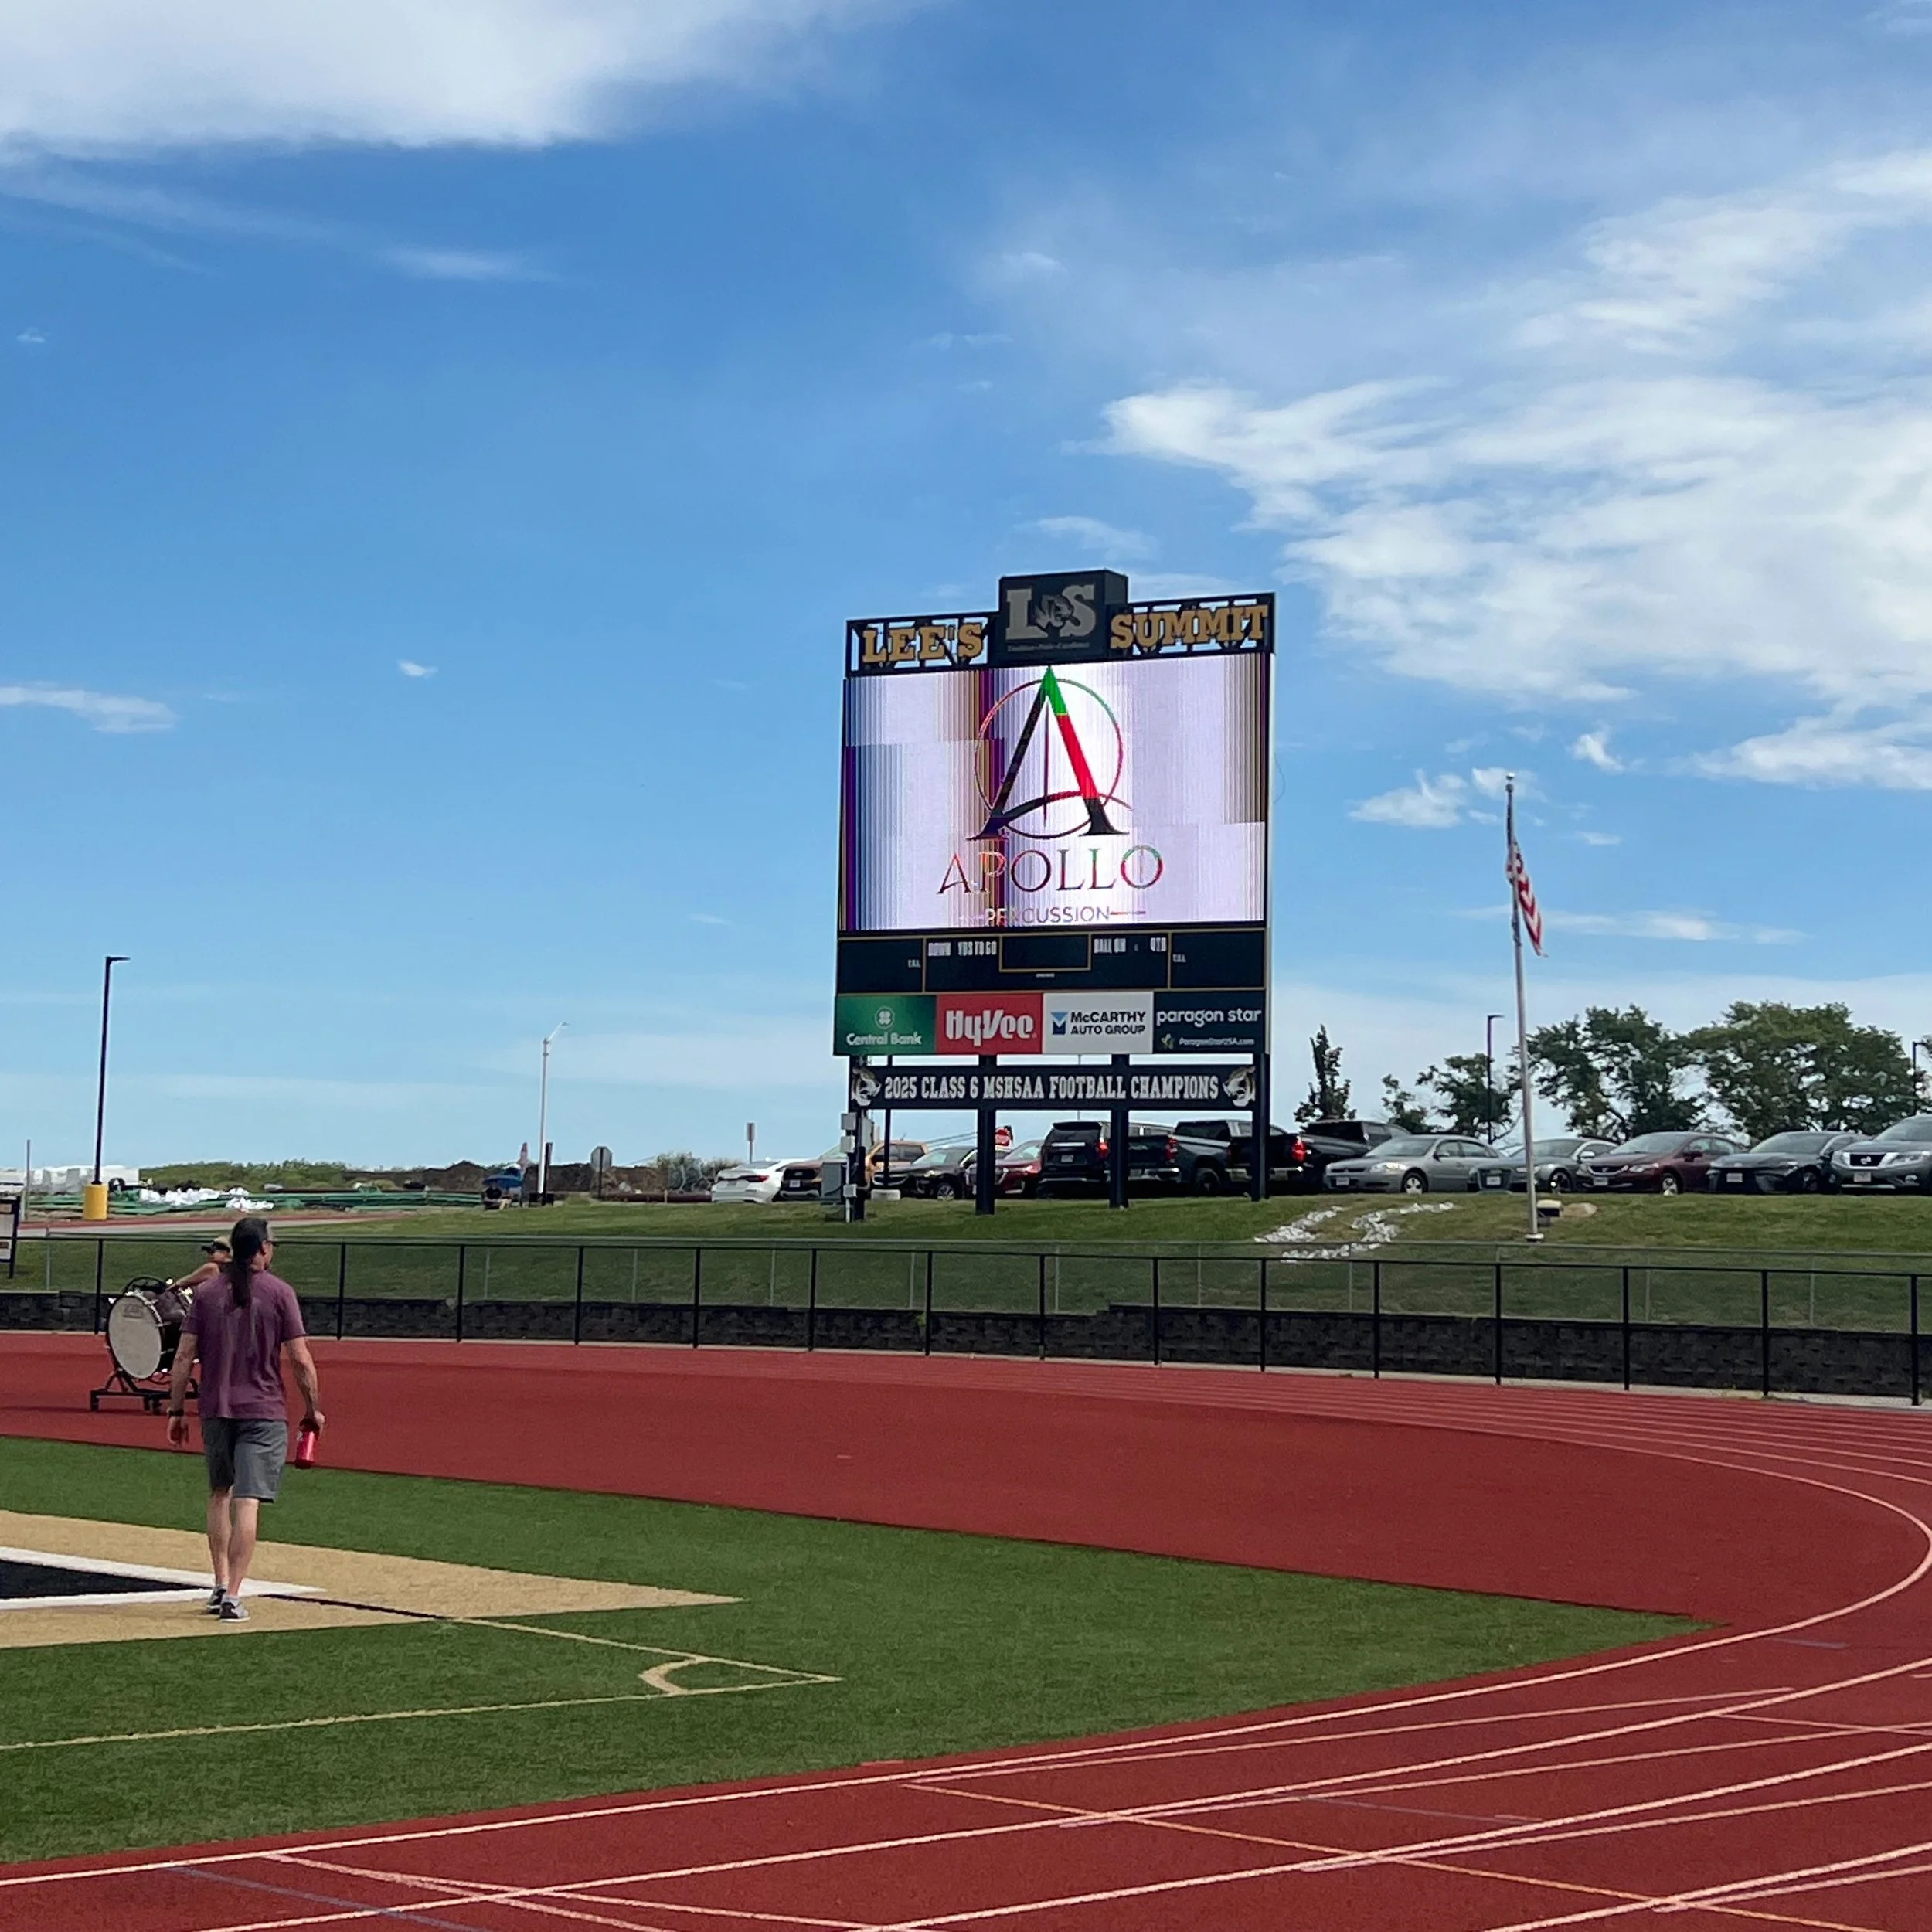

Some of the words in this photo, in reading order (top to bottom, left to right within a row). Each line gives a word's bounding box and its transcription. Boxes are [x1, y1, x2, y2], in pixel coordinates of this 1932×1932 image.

[862, 624, 982, 662] LEE'S
[1110, 605, 1268, 648] SUMMIT
[937, 845, 1163, 894] APOLLO
[1070, 1011, 1146, 1023] McCARTHY
[1156, 1009, 1223, 1028] paragon
[1227, 1008, 1262, 1022] star
[846, 1032, 887, 1046] Central
[890, 1032, 922, 1045] Bank
[1070, 1025, 1102, 1036] AUTO
[1105, 1024, 1146, 1036] GROUP
[884, 1077, 917, 1099] 2025
[921, 1076, 965, 1099] CLASS
[970, 1076, 978, 1099] 6
[982, 1076, 1044, 1099] MSHSAA
[1049, 1075, 1126, 1099] FOOTBALL
[1130, 1075, 1219, 1099] CHAMPIONS
